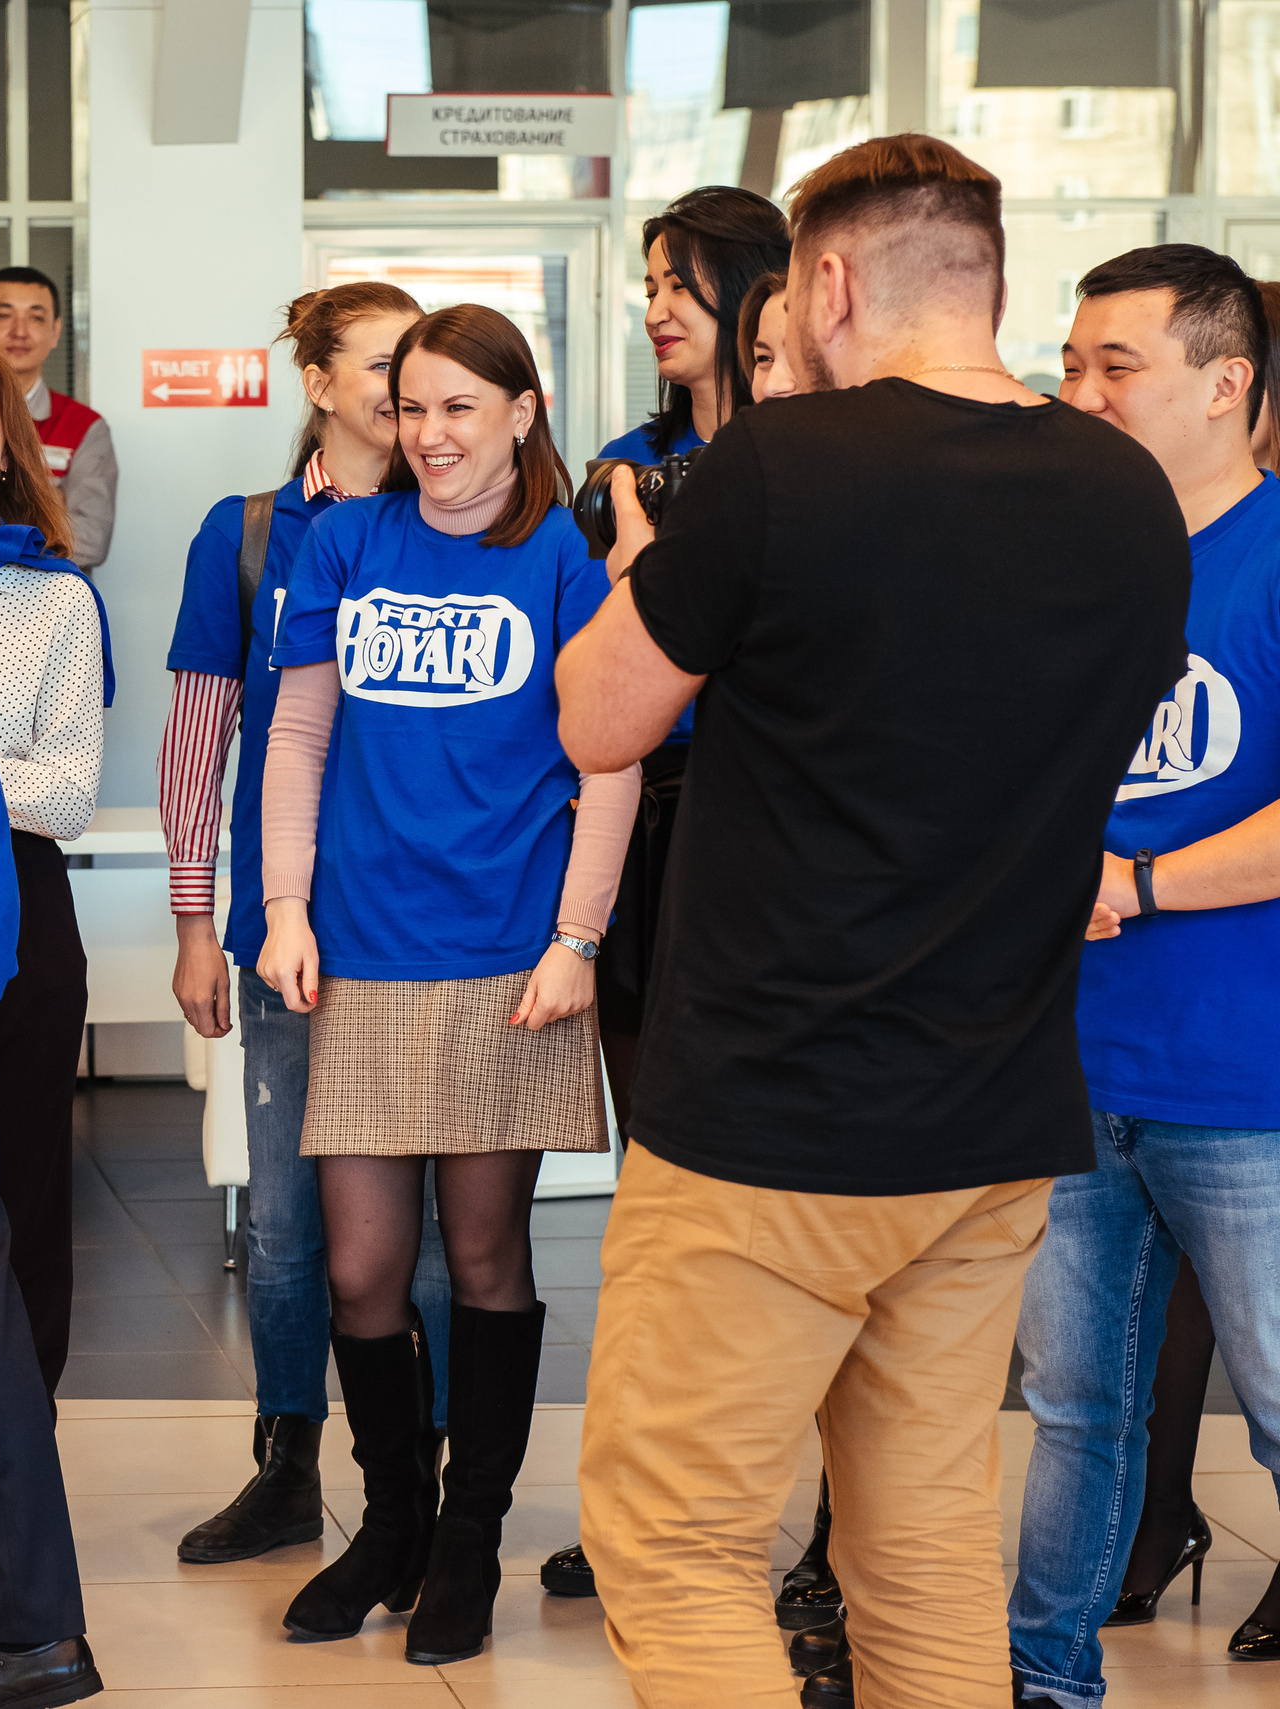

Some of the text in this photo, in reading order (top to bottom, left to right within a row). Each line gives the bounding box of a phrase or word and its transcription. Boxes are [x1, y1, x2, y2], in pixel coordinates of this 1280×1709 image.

[432, 106, 574, 124] КРЕДИТОВАНИЕ
[439, 129, 566, 147] СТРАХОВАНИЕ
[150, 360, 210, 377] ТУАЛЕТ
[378, 602, 480, 629] FORT
[336, 598, 535, 692] BOYARD
